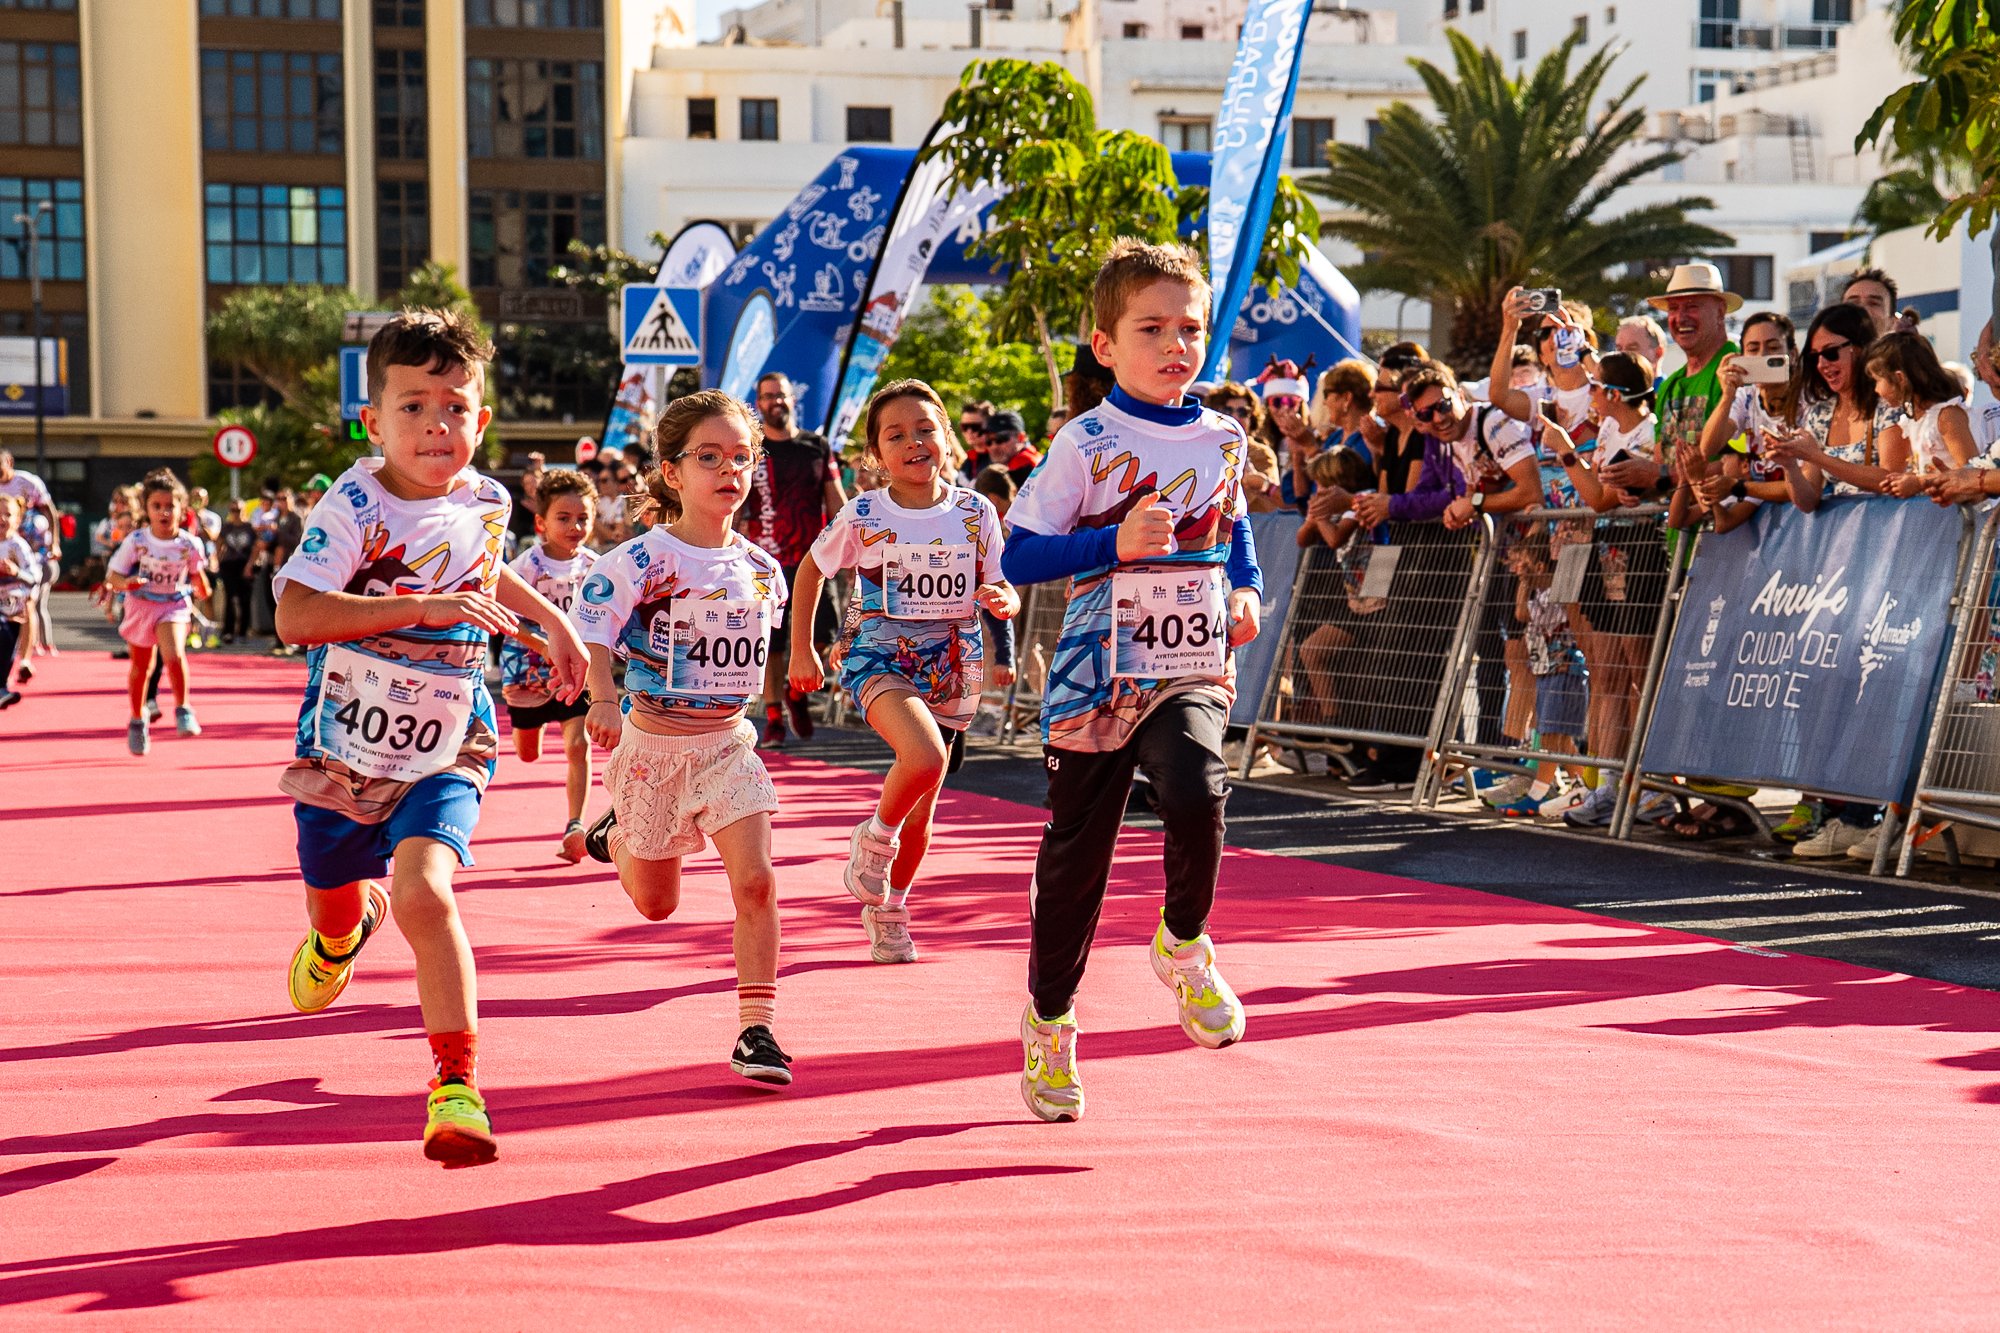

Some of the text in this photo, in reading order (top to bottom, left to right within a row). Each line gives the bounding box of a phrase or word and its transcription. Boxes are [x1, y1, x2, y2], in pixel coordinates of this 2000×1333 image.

[1084, 442, 1117, 458] Arrecife
[897, 573, 966, 599] 4009
[1131, 611, 1225, 650] 4034
[686, 636, 766, 668] 4006
[1155, 651, 1215, 660] AYRTON RODRIGUES
[1737, 630, 1798, 666] CIUDA
[433, 689, 451, 700] 200
[335, 698, 442, 753] 4030
[360, 746, 393, 760] QUINTERO
